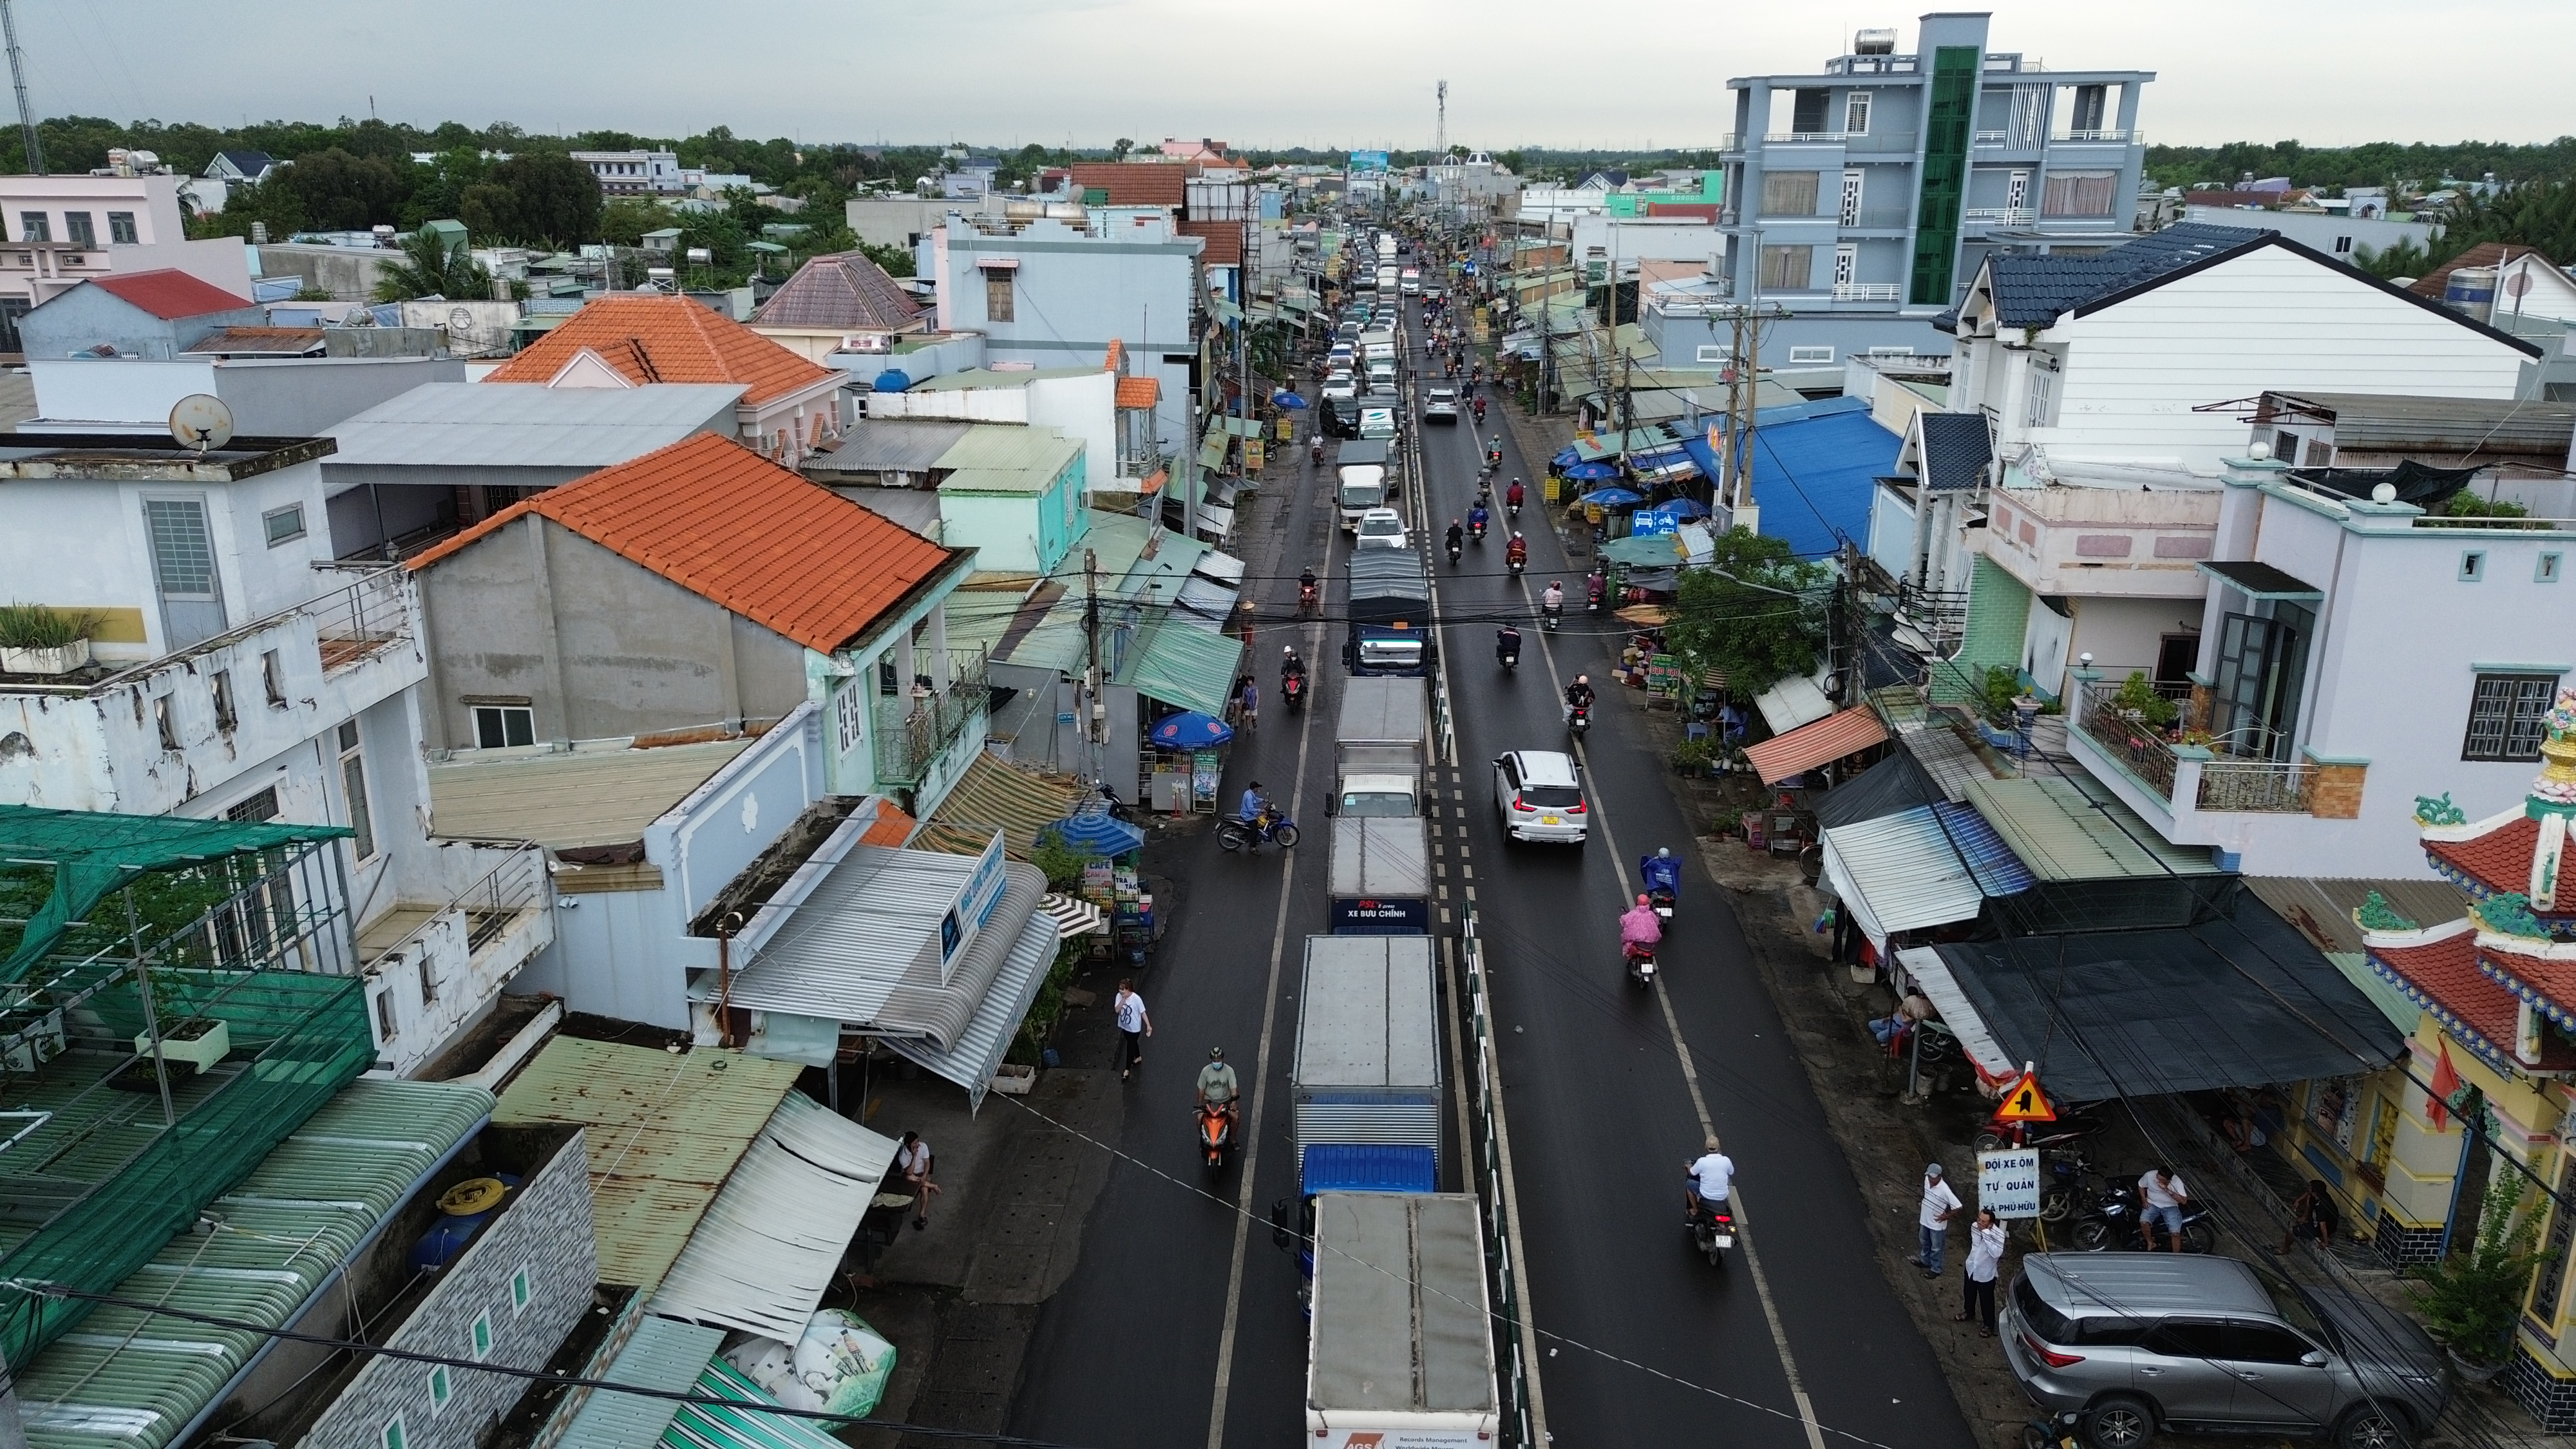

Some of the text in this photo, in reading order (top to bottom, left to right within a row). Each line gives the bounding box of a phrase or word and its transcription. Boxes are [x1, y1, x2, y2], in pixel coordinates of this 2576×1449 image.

[1360, 909, 1376, 918] BƯU
[1378, 909, 1406, 918] CHÍNH
[1985, 1156, 2034, 1172] ĐỘI XE ÔM
[1985, 1177, 2034, 1194] TỰ QUẢN
[2018, 1200, 2036, 1211] HỮU
